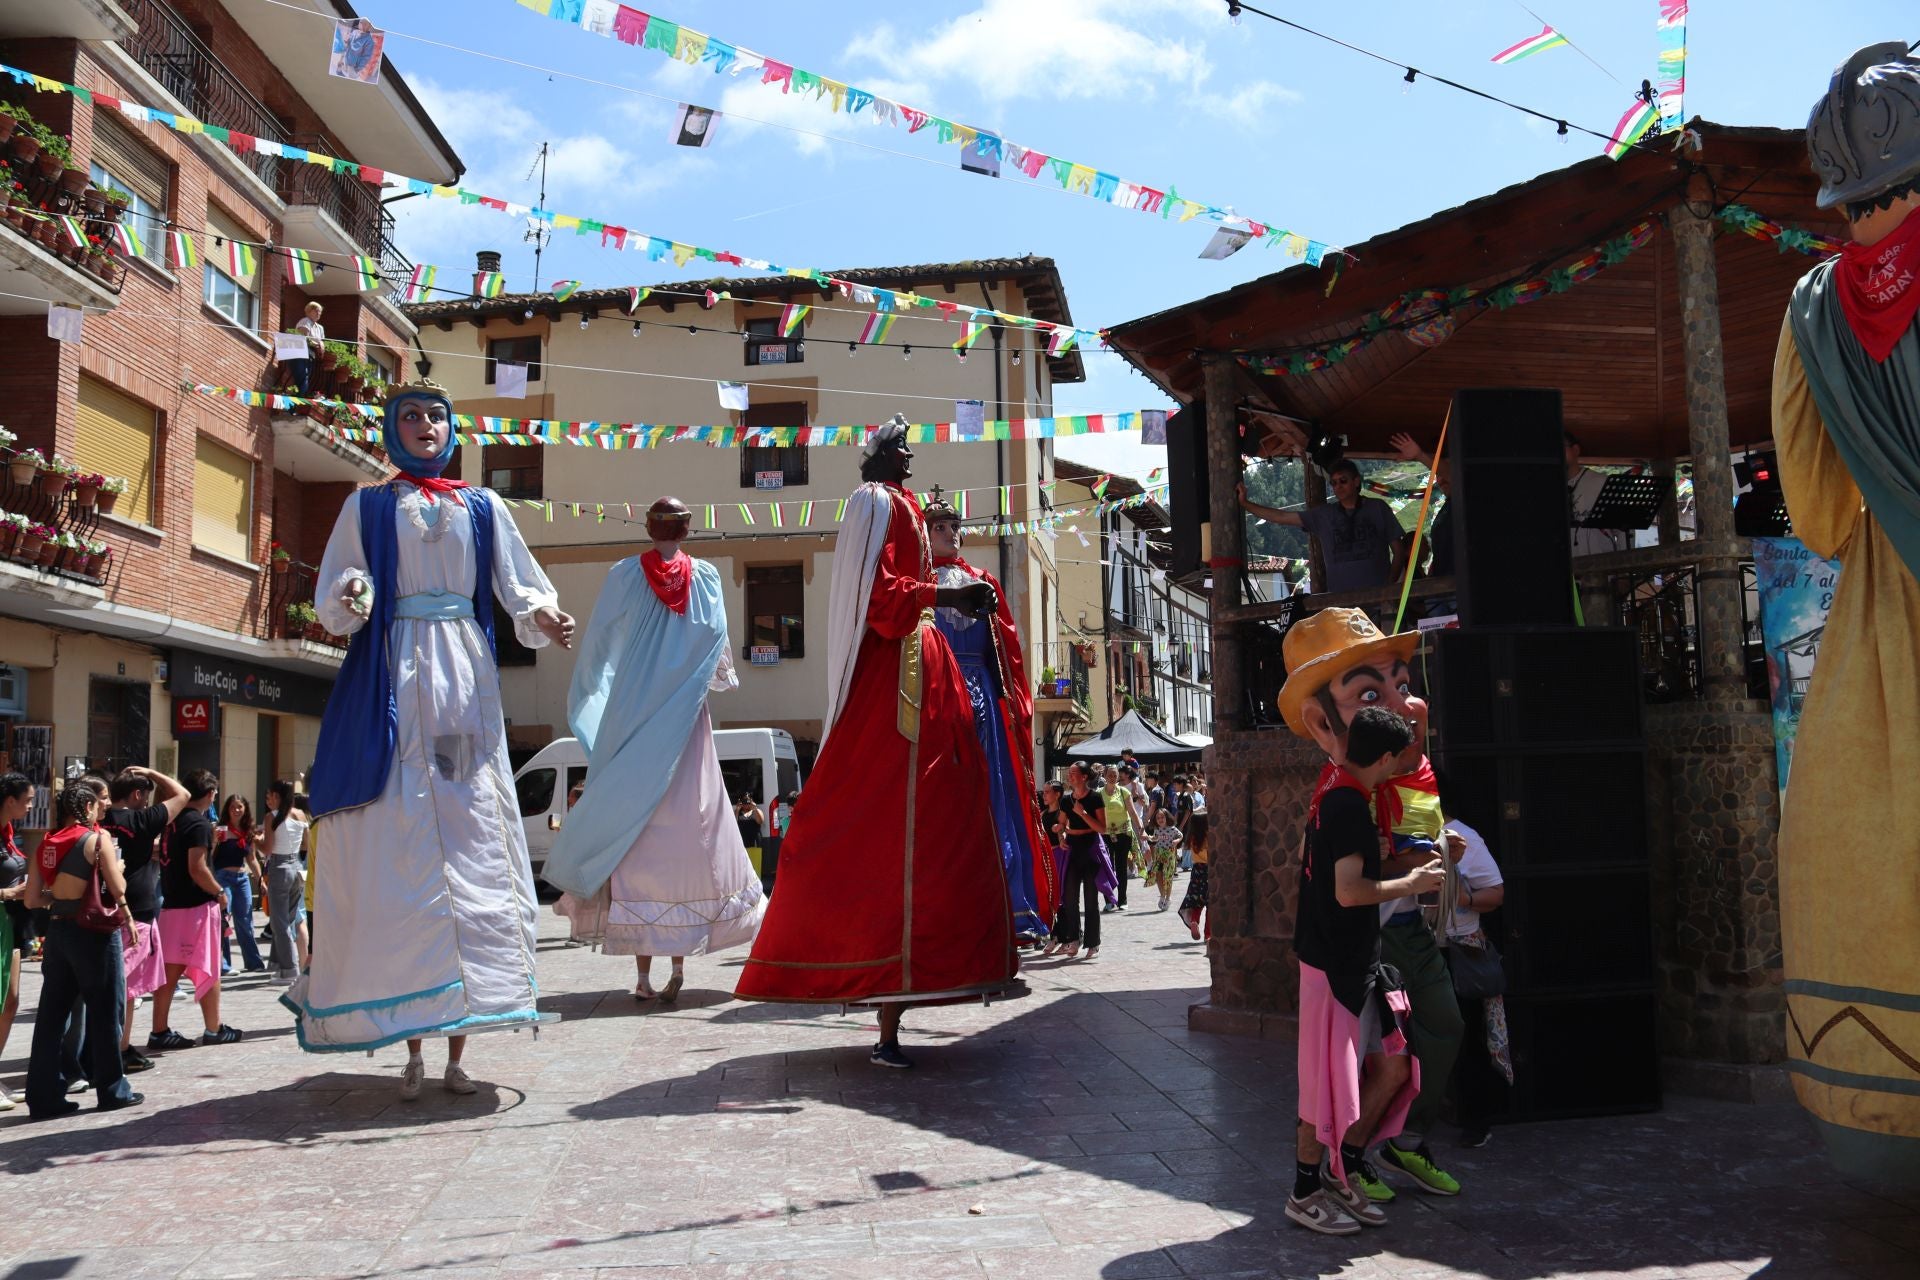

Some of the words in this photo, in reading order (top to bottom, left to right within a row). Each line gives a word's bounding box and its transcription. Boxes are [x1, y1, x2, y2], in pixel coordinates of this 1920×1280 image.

[1763, 543, 1808, 560] Santa
[1773, 574, 1797, 588] del
[1804, 574, 1813, 588] 7
[1820, 574, 1835, 588] al
[194, 665, 238, 694] iberCaja
[258, 679, 281, 702] Rioja
[182, 703, 206, 718] CA
